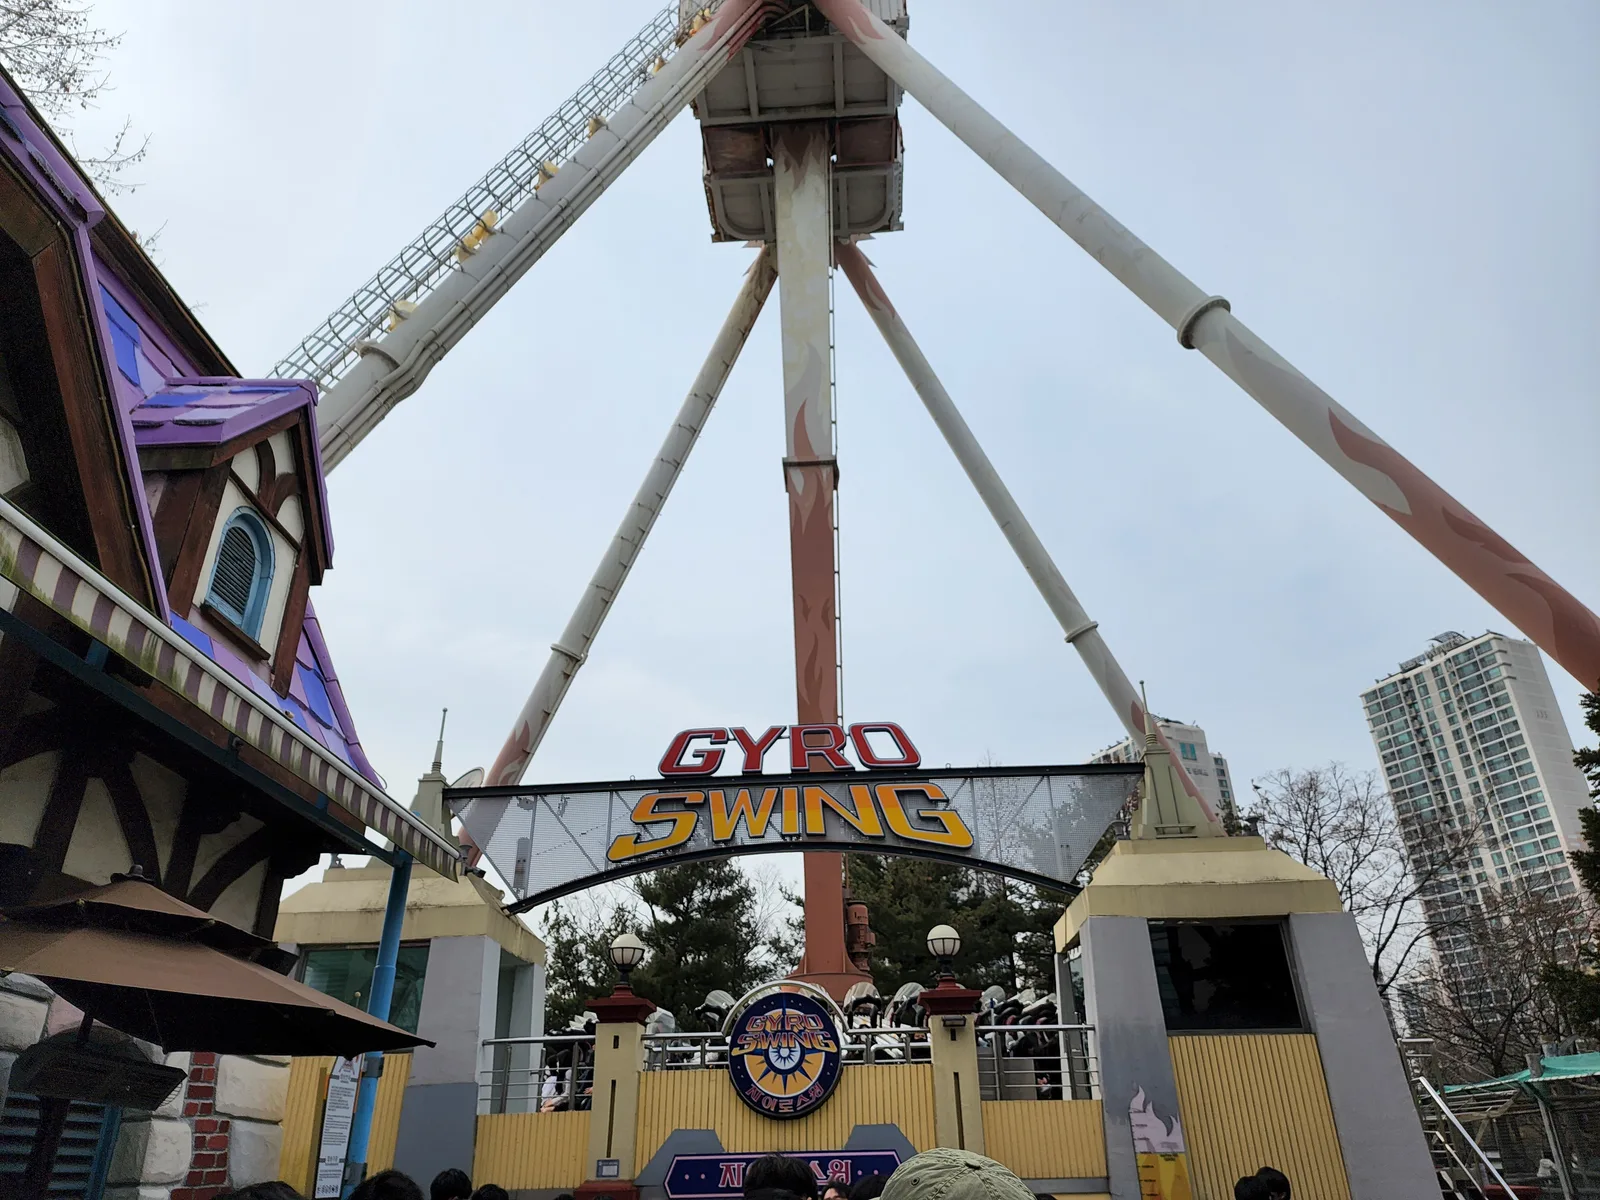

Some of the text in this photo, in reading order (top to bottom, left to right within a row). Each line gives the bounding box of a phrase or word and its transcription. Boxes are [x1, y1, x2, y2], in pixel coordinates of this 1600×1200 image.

[658, 722, 921, 778] GYRO
[606, 782, 974, 863] SWING
[745, 1014, 824, 1031] GYRO
[731, 1031, 838, 1057] SWING
[745, 1081, 825, 1113] 자이로스윙
